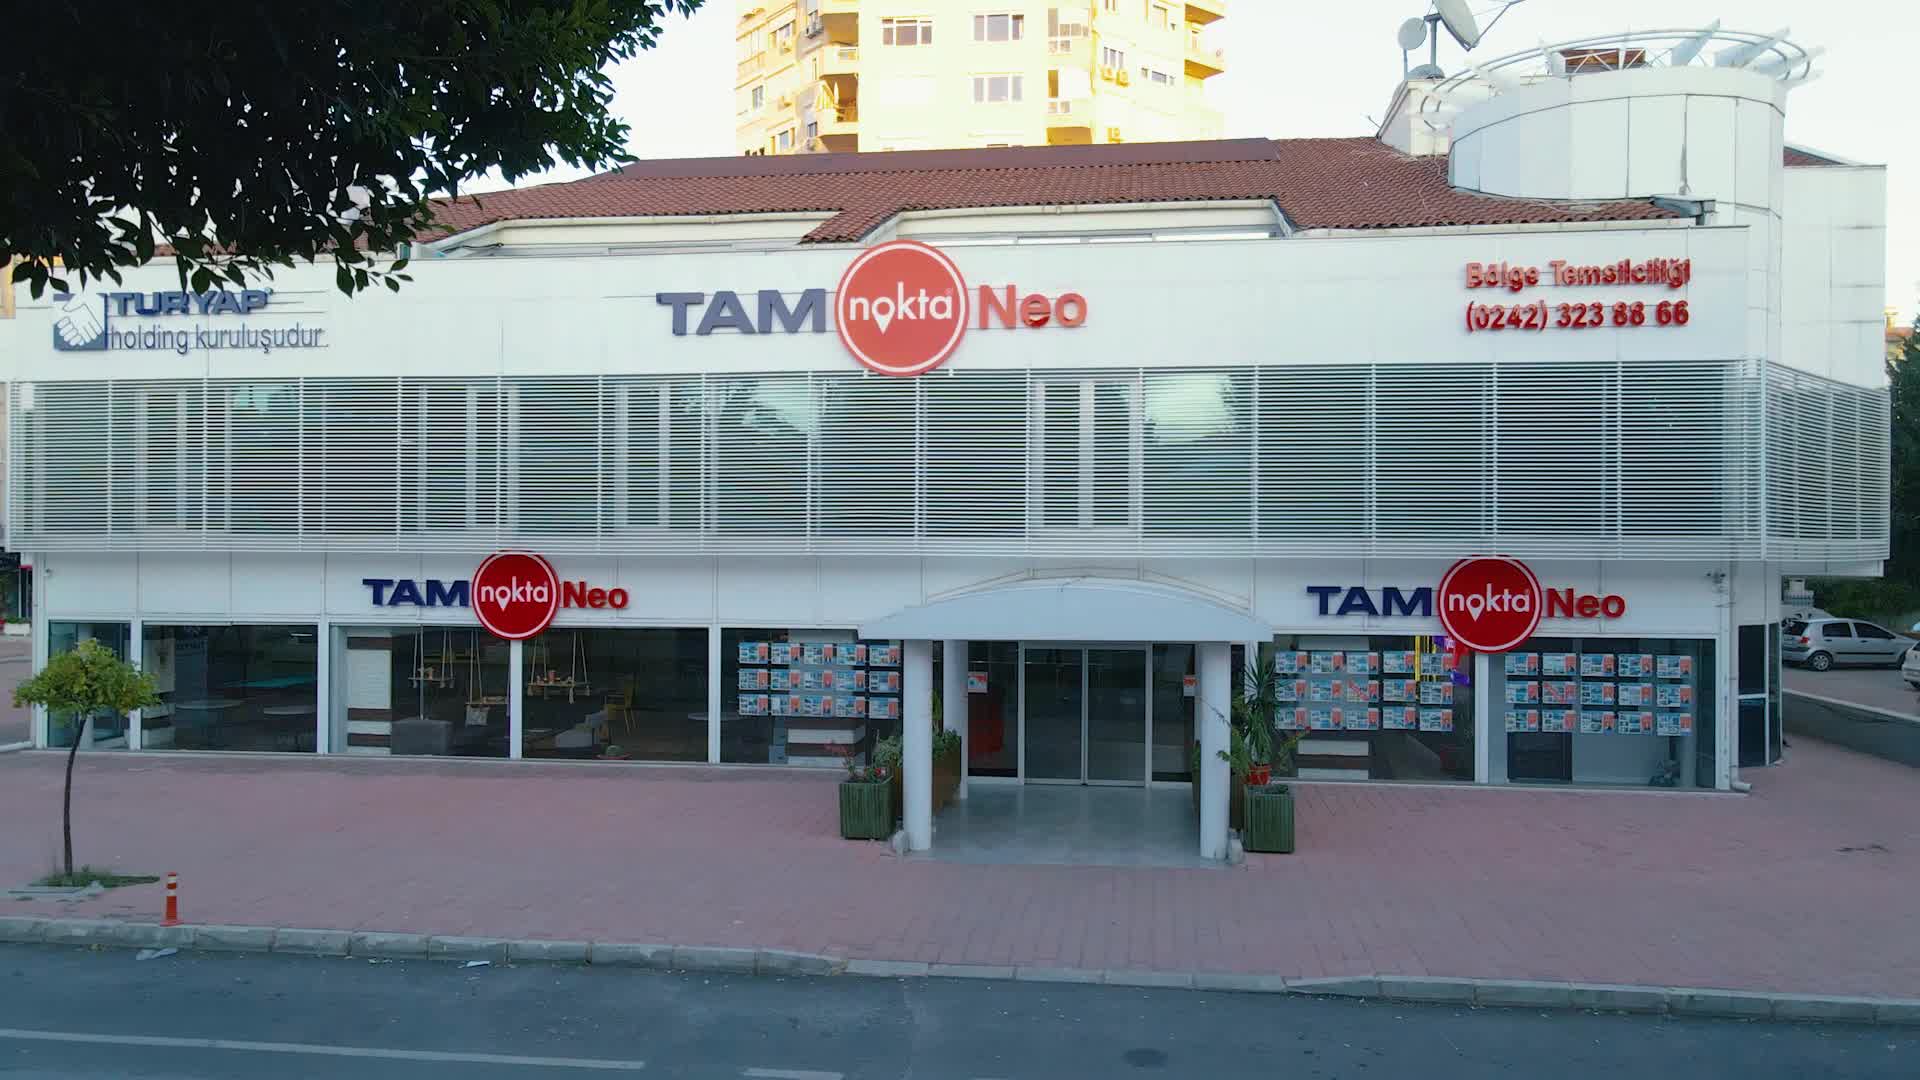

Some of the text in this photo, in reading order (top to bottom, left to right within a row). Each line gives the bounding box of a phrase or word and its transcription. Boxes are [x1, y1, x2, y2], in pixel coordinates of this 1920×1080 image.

[656, 282, 1088, 336] TAM nokta Neo
[1465, 299, 1689, 332] (0242) 323 88 66
[111, 322, 323, 355] holding kuruluşudur
[362, 576, 629, 612] TAM nokta Neo
[1307, 583, 1626, 622] TAM nokta Neo
